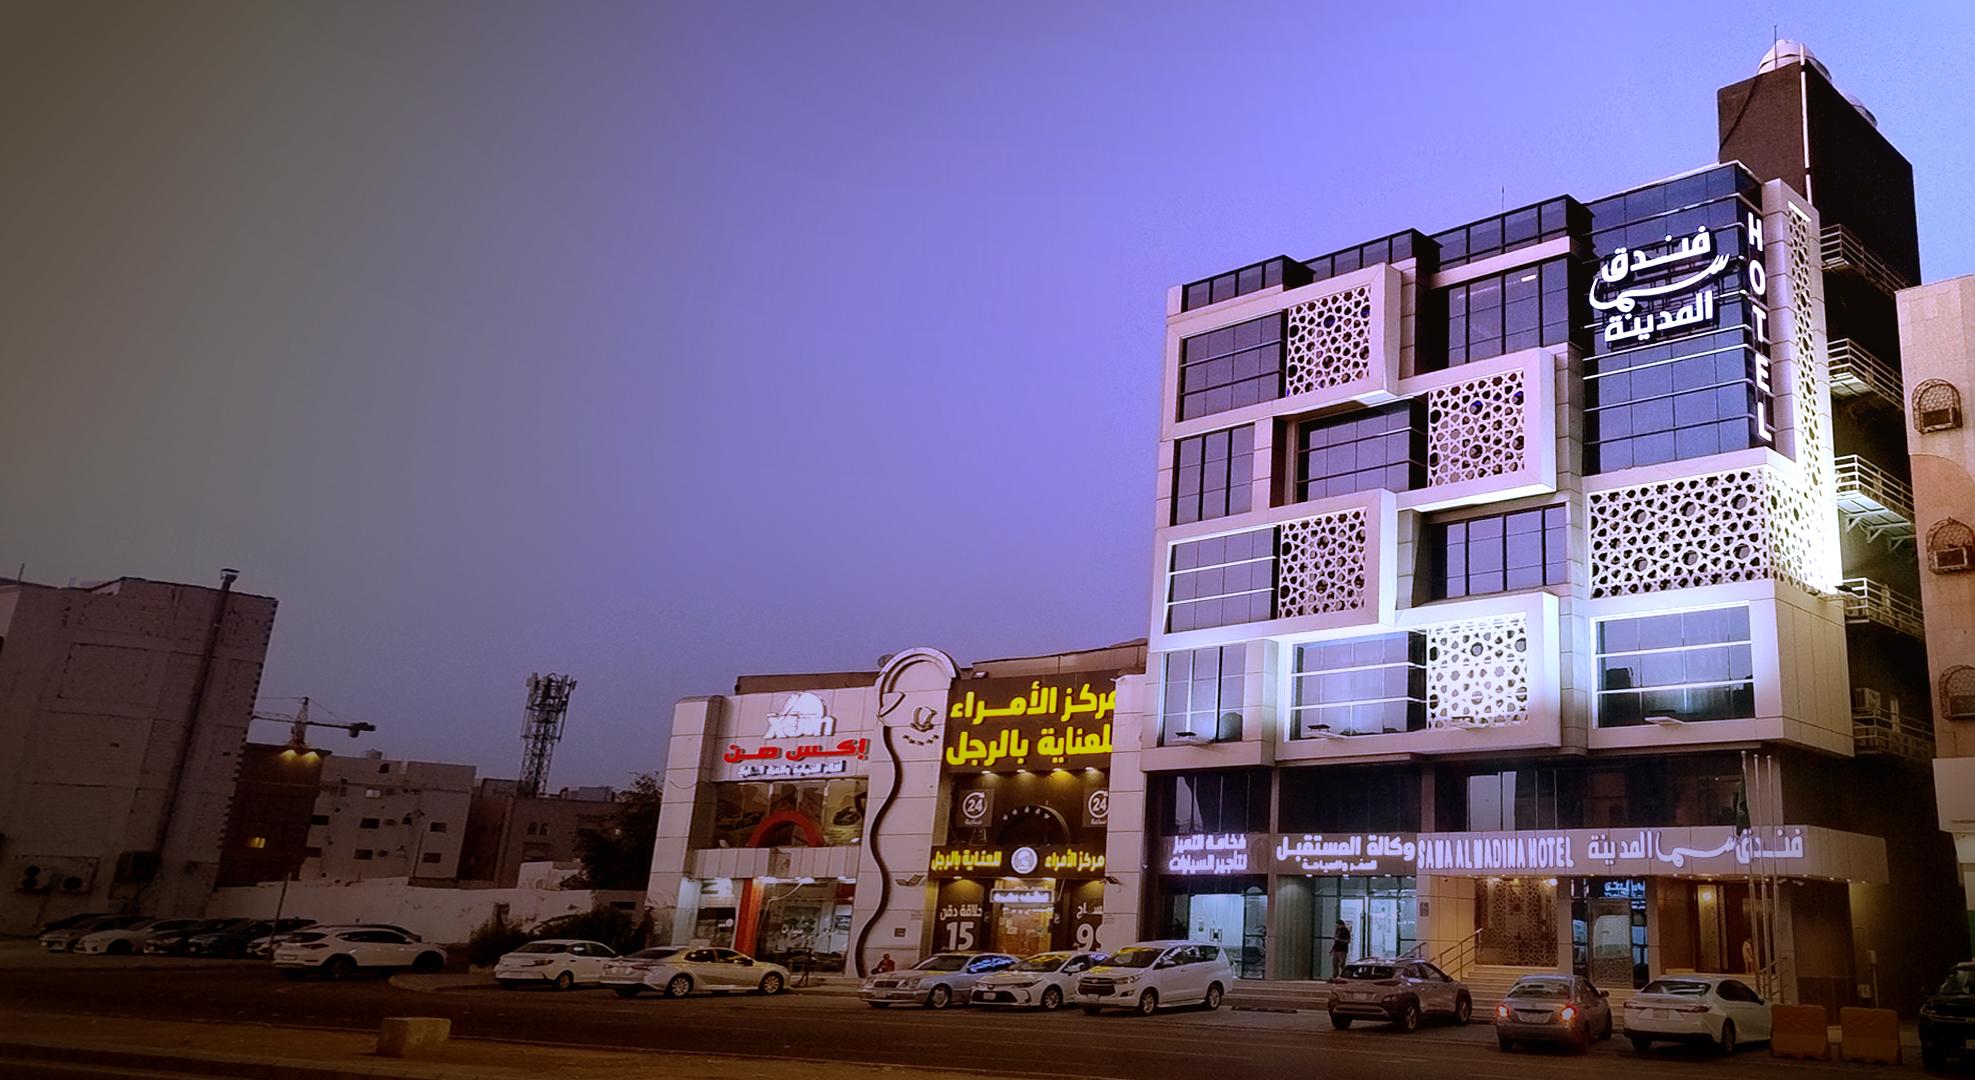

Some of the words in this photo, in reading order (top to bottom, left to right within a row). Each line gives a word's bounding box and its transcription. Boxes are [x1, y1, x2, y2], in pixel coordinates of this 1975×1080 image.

[1601, 225, 1711, 282] فندق
[1604, 290, 1714, 342] المدينة
[1747, 211, 1773, 442] HOTEL
[950, 680, 1058, 726] الأمراء
[785, 738, 869, 761] إكس
[946, 728, 1030, 767] بالرجل
[967, 799, 984, 812] 24
[1093, 797, 1107, 811] 24
[1078, 852, 1106, 872] مركز
[1276, 834, 1361, 862] المستقبل
[1366, 834, 1416, 861] وكالة
[1455, 839, 1473, 869] AL
[1528, 836, 1574, 868] HOTEL
[1588, 831, 1653, 866] المدينة
[1735, 828, 1804, 865] فندق
[946, 922, 975, 951] 15
